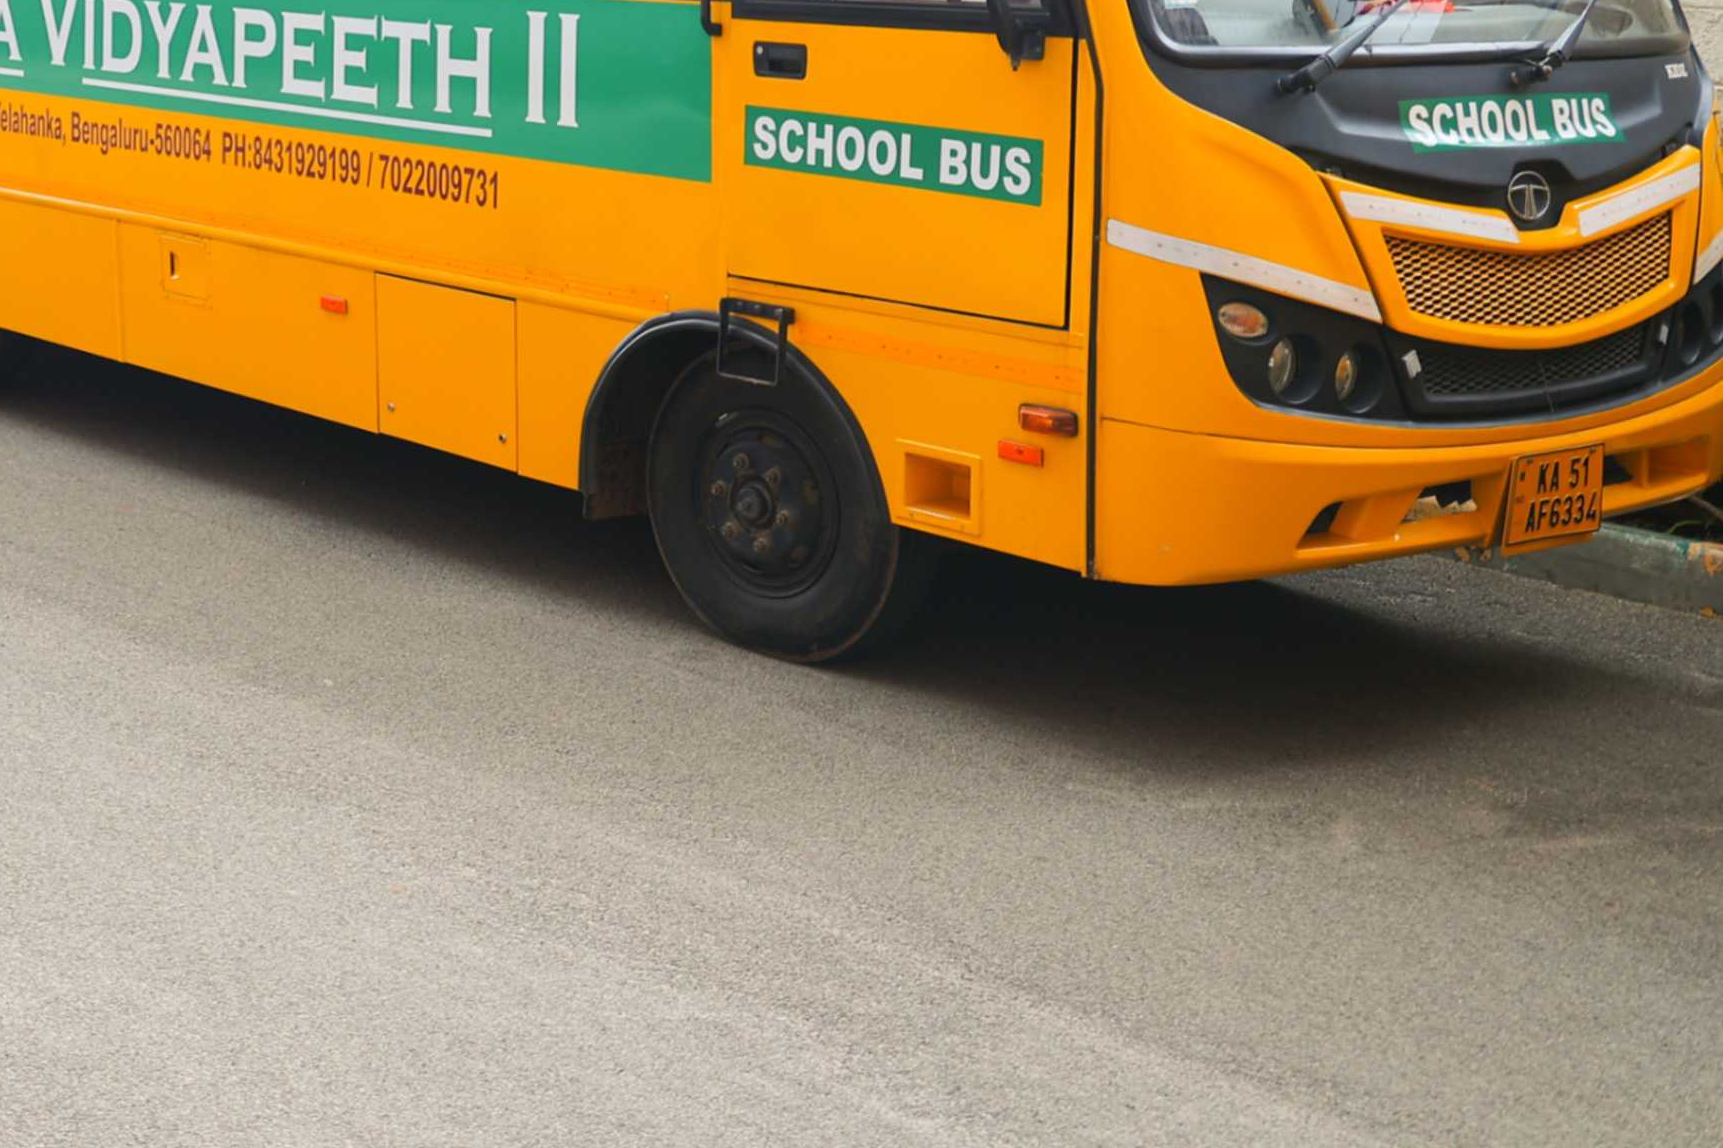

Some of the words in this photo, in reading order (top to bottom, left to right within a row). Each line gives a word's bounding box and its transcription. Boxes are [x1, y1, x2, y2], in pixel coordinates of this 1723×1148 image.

[1408, 99, 1551, 147] SCHOOL
[1550, 97, 1617, 139] BUS
[752, 115, 924, 181] SCHOOL
[939, 137, 1032, 196] BUS
[379, 154, 499, 209] 7022009731
[1537, 460, 1560, 494] KA
[1569, 455, 1590, 489] 51
[1524, 491, 1597, 533] AF6334
